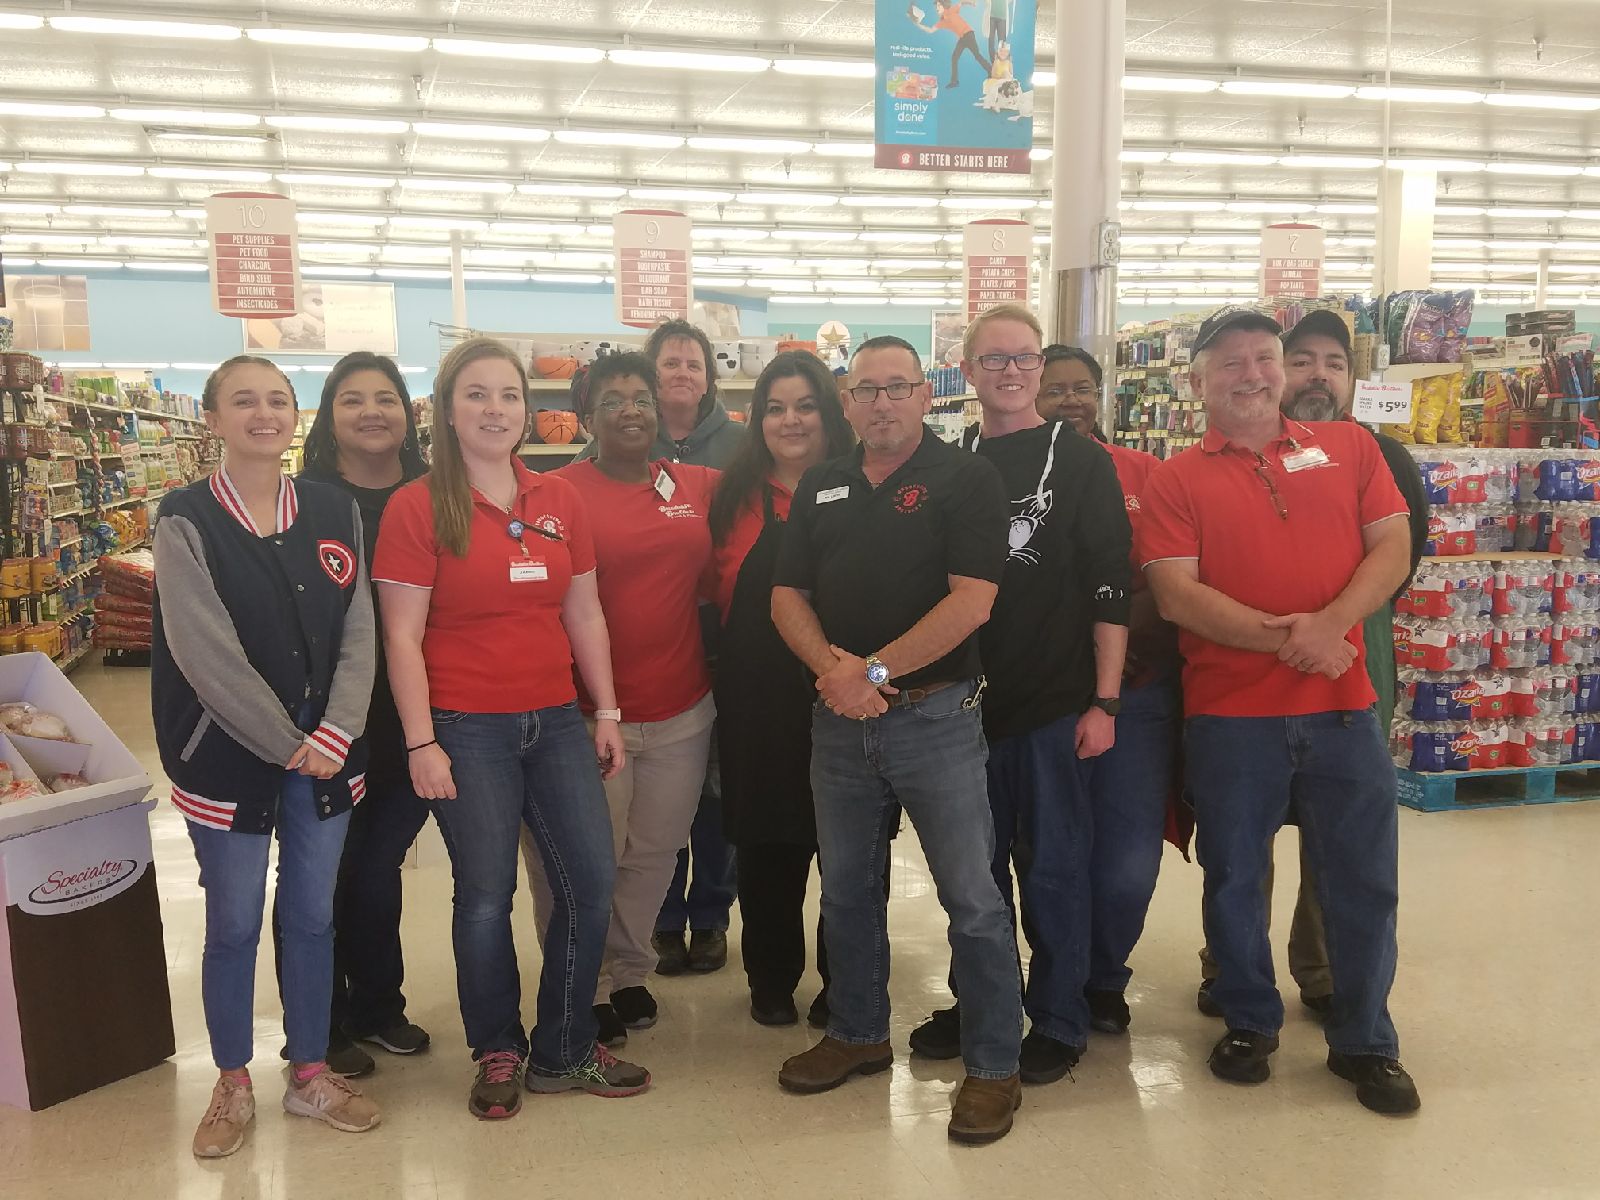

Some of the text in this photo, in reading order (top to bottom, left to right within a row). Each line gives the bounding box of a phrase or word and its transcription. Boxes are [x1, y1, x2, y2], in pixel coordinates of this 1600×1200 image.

[894, 100, 929, 114] simply
[897, 111, 924, 122] done
[919, 152, 1009, 168] BETTER STARTS HERE
[239, 204, 266, 228] 10
[646, 220, 660, 243] 9
[232, 234, 275, 245] PET SUPPLIES
[992, 228, 1006, 252] 8
[239, 247, 269, 257] PET FOOD
[639, 249, 666, 259] SHAMPOO
[238, 260, 271, 271] CHARCOAL
[256, 274, 272, 283] SEED
[237, 286, 276, 296] AUTOMOTIVE
[654, 286, 668, 295] SOAP
[236, 299, 278, 309] INSECTICIDES
[41, 860, 122, 895] Specialty
